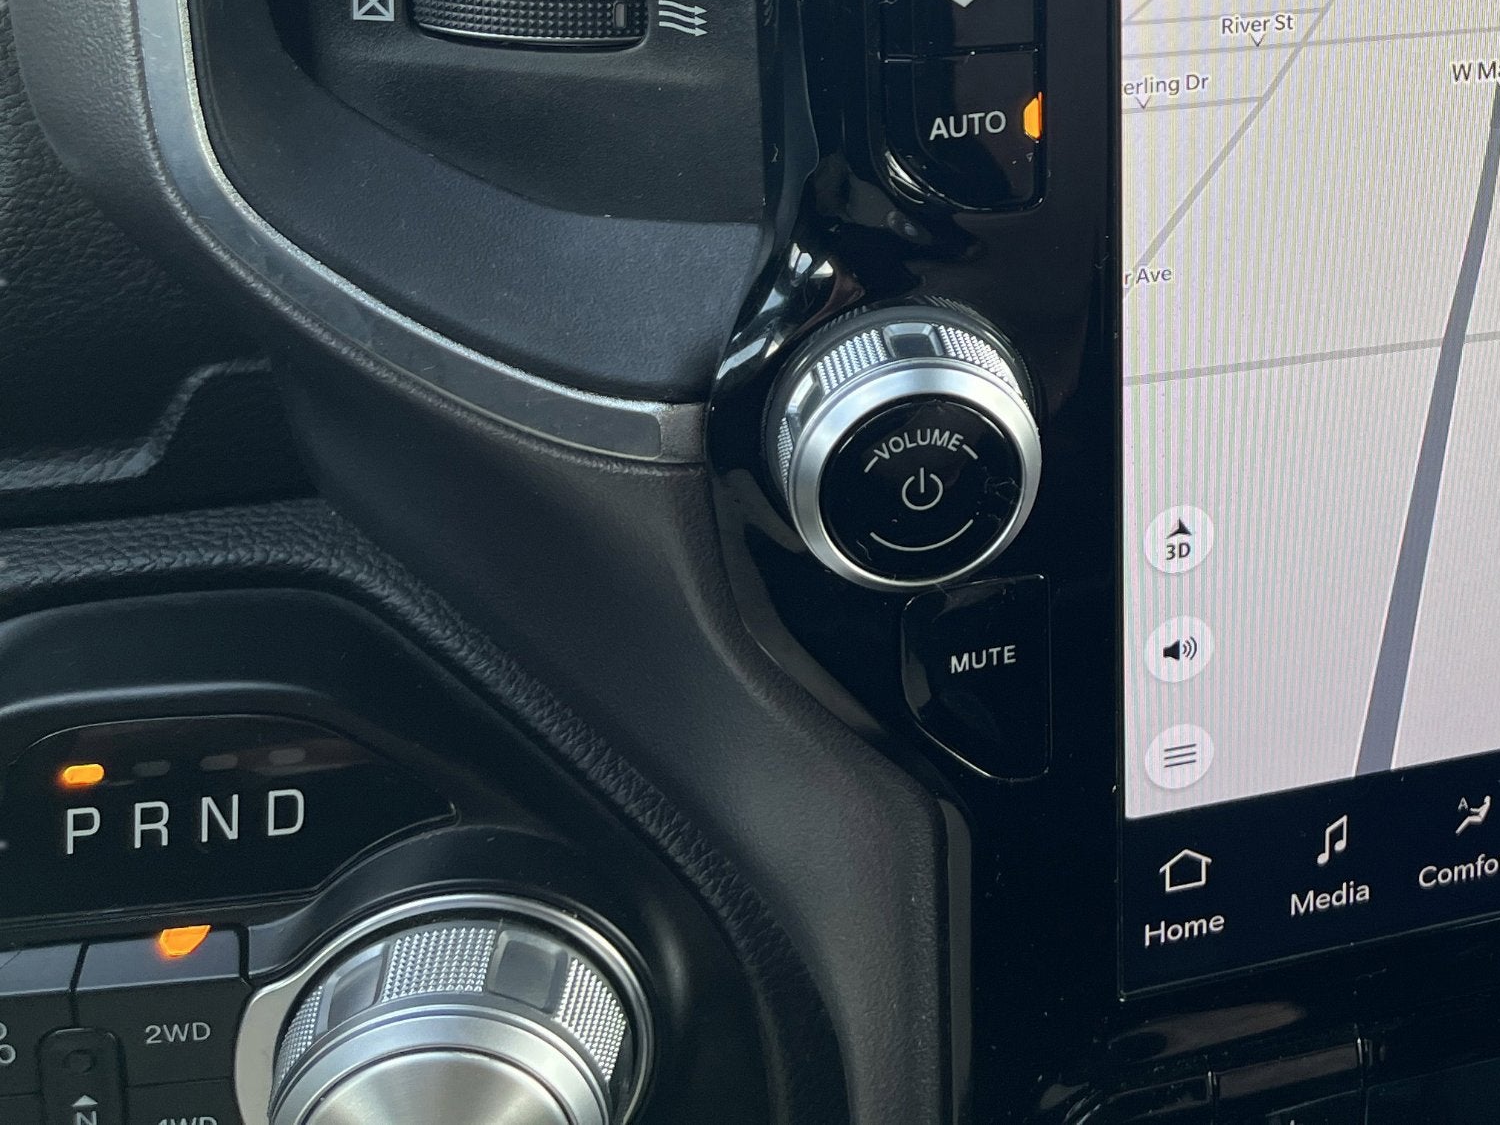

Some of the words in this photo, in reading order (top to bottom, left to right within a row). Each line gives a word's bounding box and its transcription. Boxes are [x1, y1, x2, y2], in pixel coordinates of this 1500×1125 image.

[1221, 16, 1271, 35] River
[1274, 14, 1294, 31] St
[1186, 74, 1209, 90] Dr
[1452, 62, 1473, 82] W
[929, 111, 1006, 141] AUTO
[1136, 268, 1172, 284] Ave
[874, 428, 964, 460] VOLUME
[1165, 541, 1191, 560] 3D
[950, 645, 1016, 673] MUTE
[67, 807, 100, 854] P
[134, 801, 169, 849] R
[201, 794, 239, 843] N
[268, 789, 305, 837] D
[1290, 881, 1370, 916] Media
[1144, 914, 1225, 947] Home
[145, 1022, 211, 1045] 2WD
